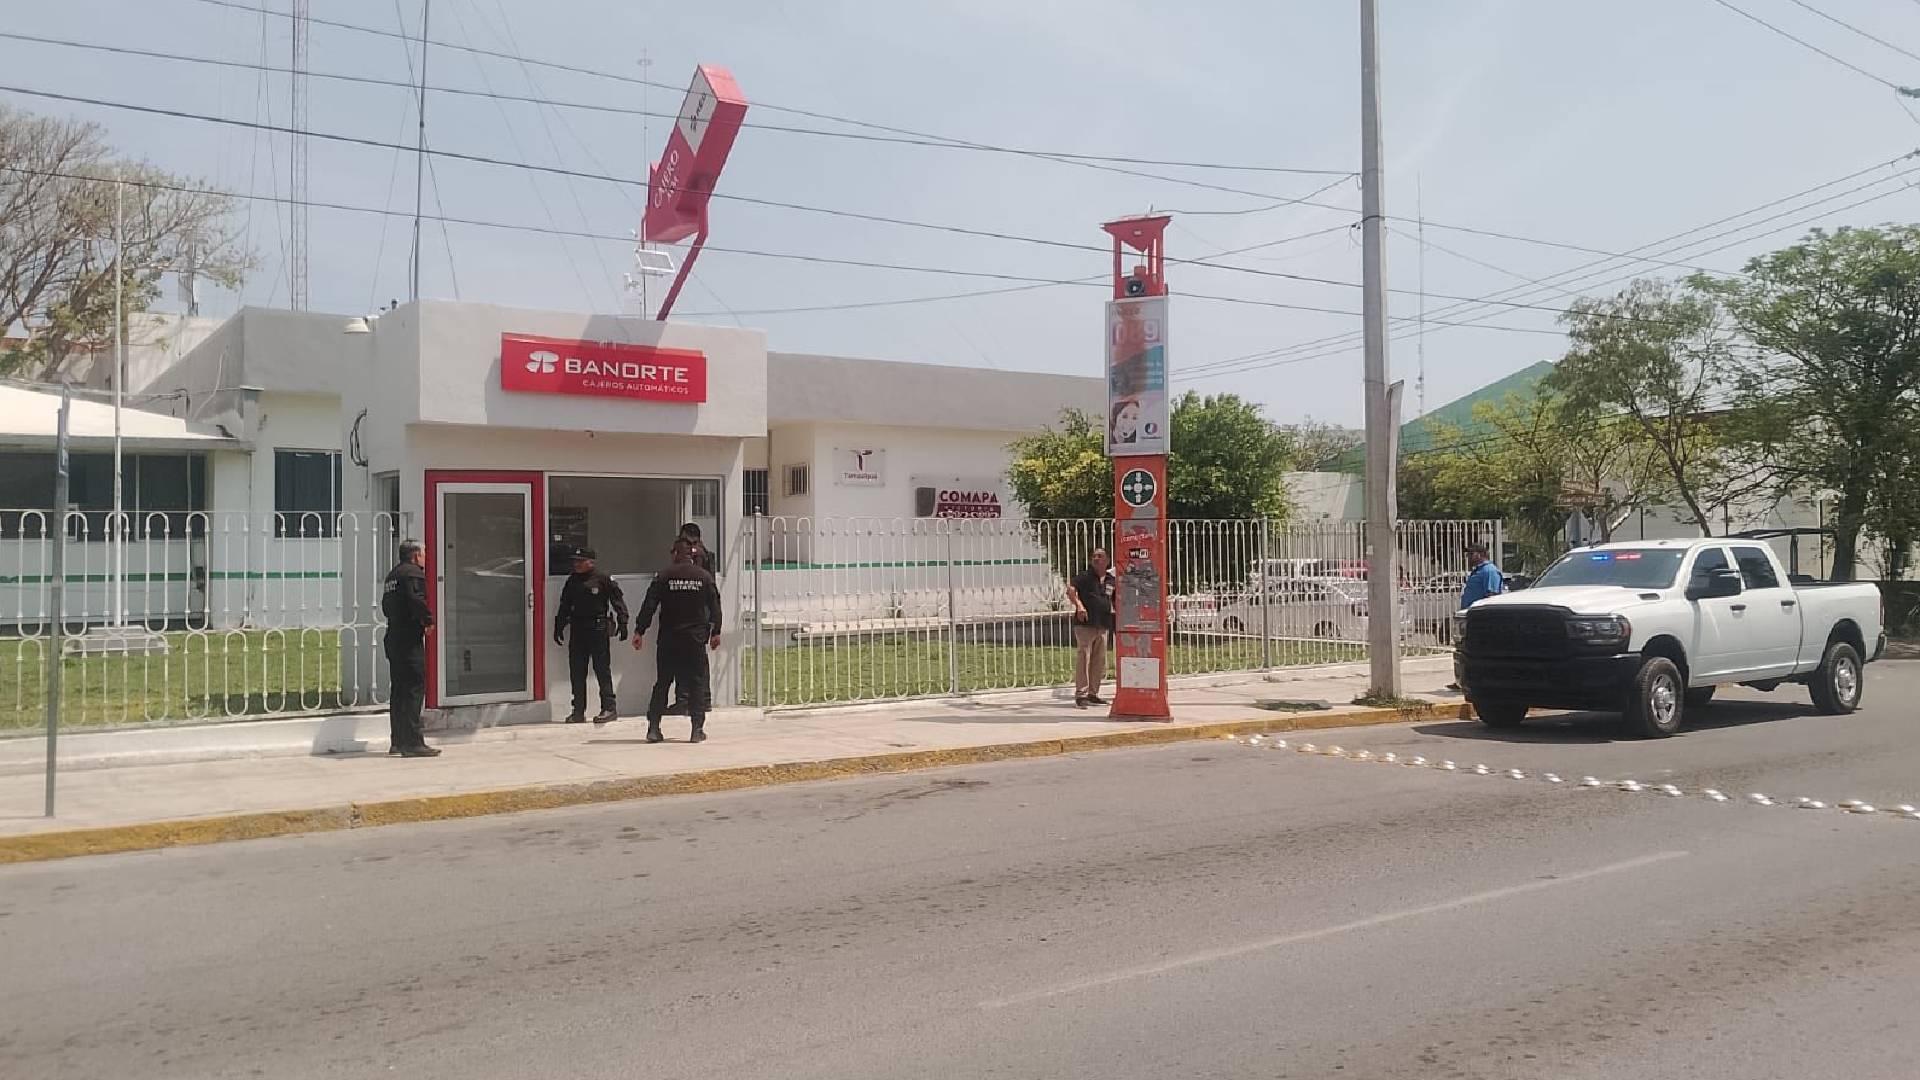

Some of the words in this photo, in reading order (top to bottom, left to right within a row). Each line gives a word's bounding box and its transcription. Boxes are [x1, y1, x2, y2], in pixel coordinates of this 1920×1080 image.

[564, 358, 689, 383] BANORTE
[582, 380, 625, 390] CAJEROS
[940, 490, 998, 503] COMAPA
